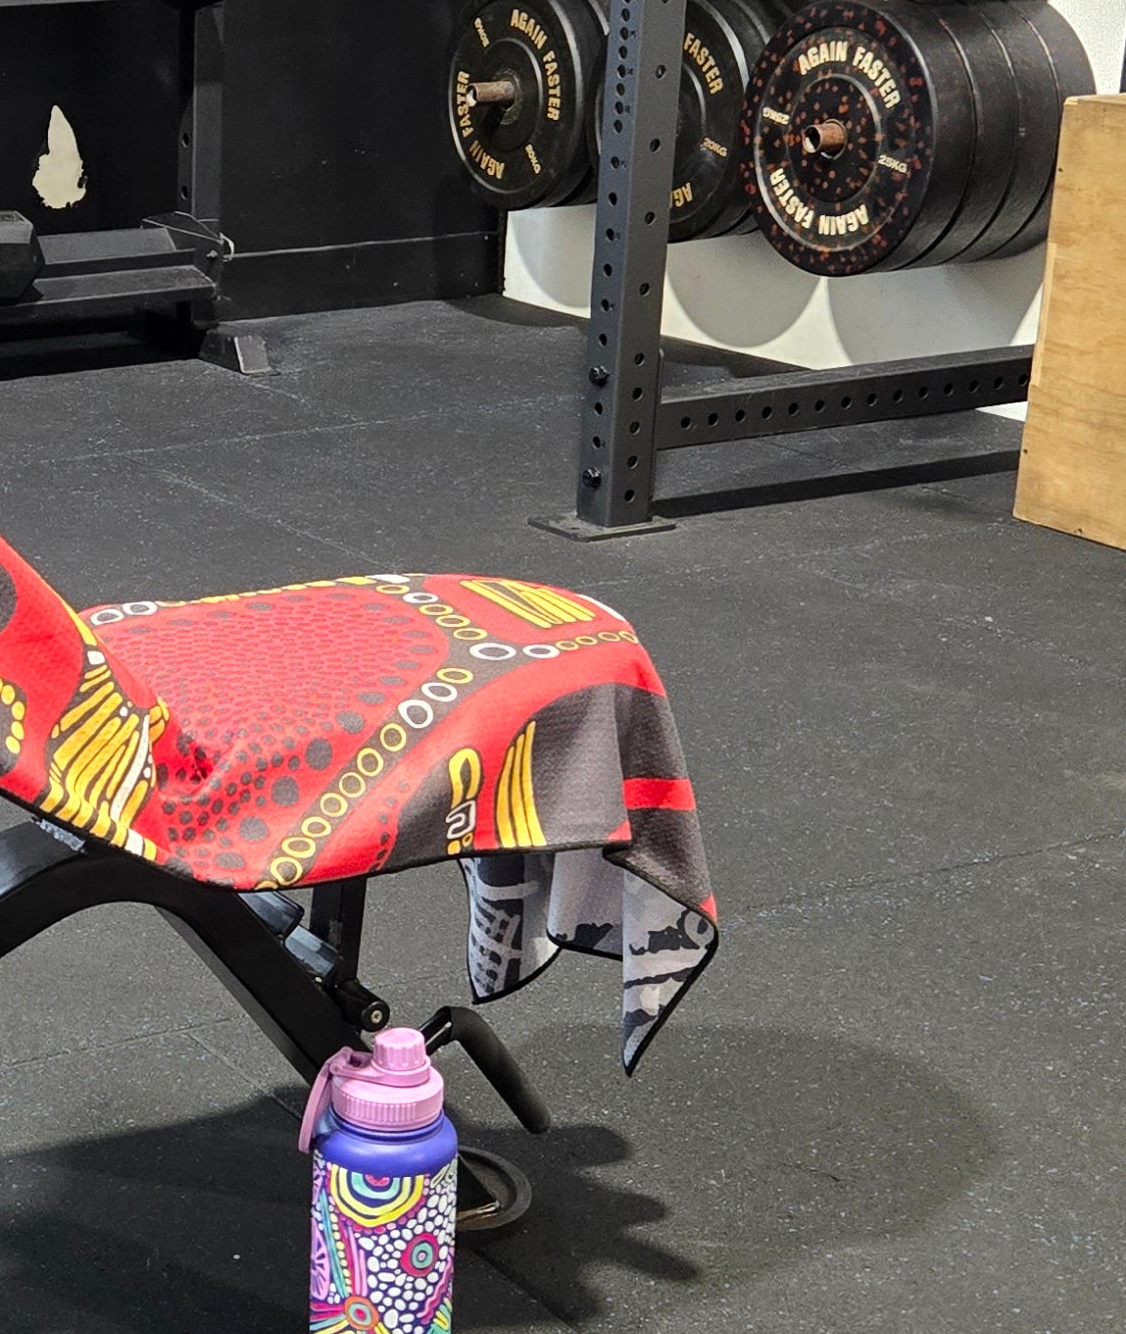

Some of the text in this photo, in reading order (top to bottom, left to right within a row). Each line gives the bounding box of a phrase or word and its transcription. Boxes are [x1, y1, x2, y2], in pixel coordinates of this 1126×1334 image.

[510, 8, 562, 122] AGAIN FASTER
[683, 32, 723, 95] FASTER
[797, 40, 902, 109] AGAIN FASTER
[469, 140, 505, 180] AGAIN
[769, 168, 869, 236] AGAIN FASTER
